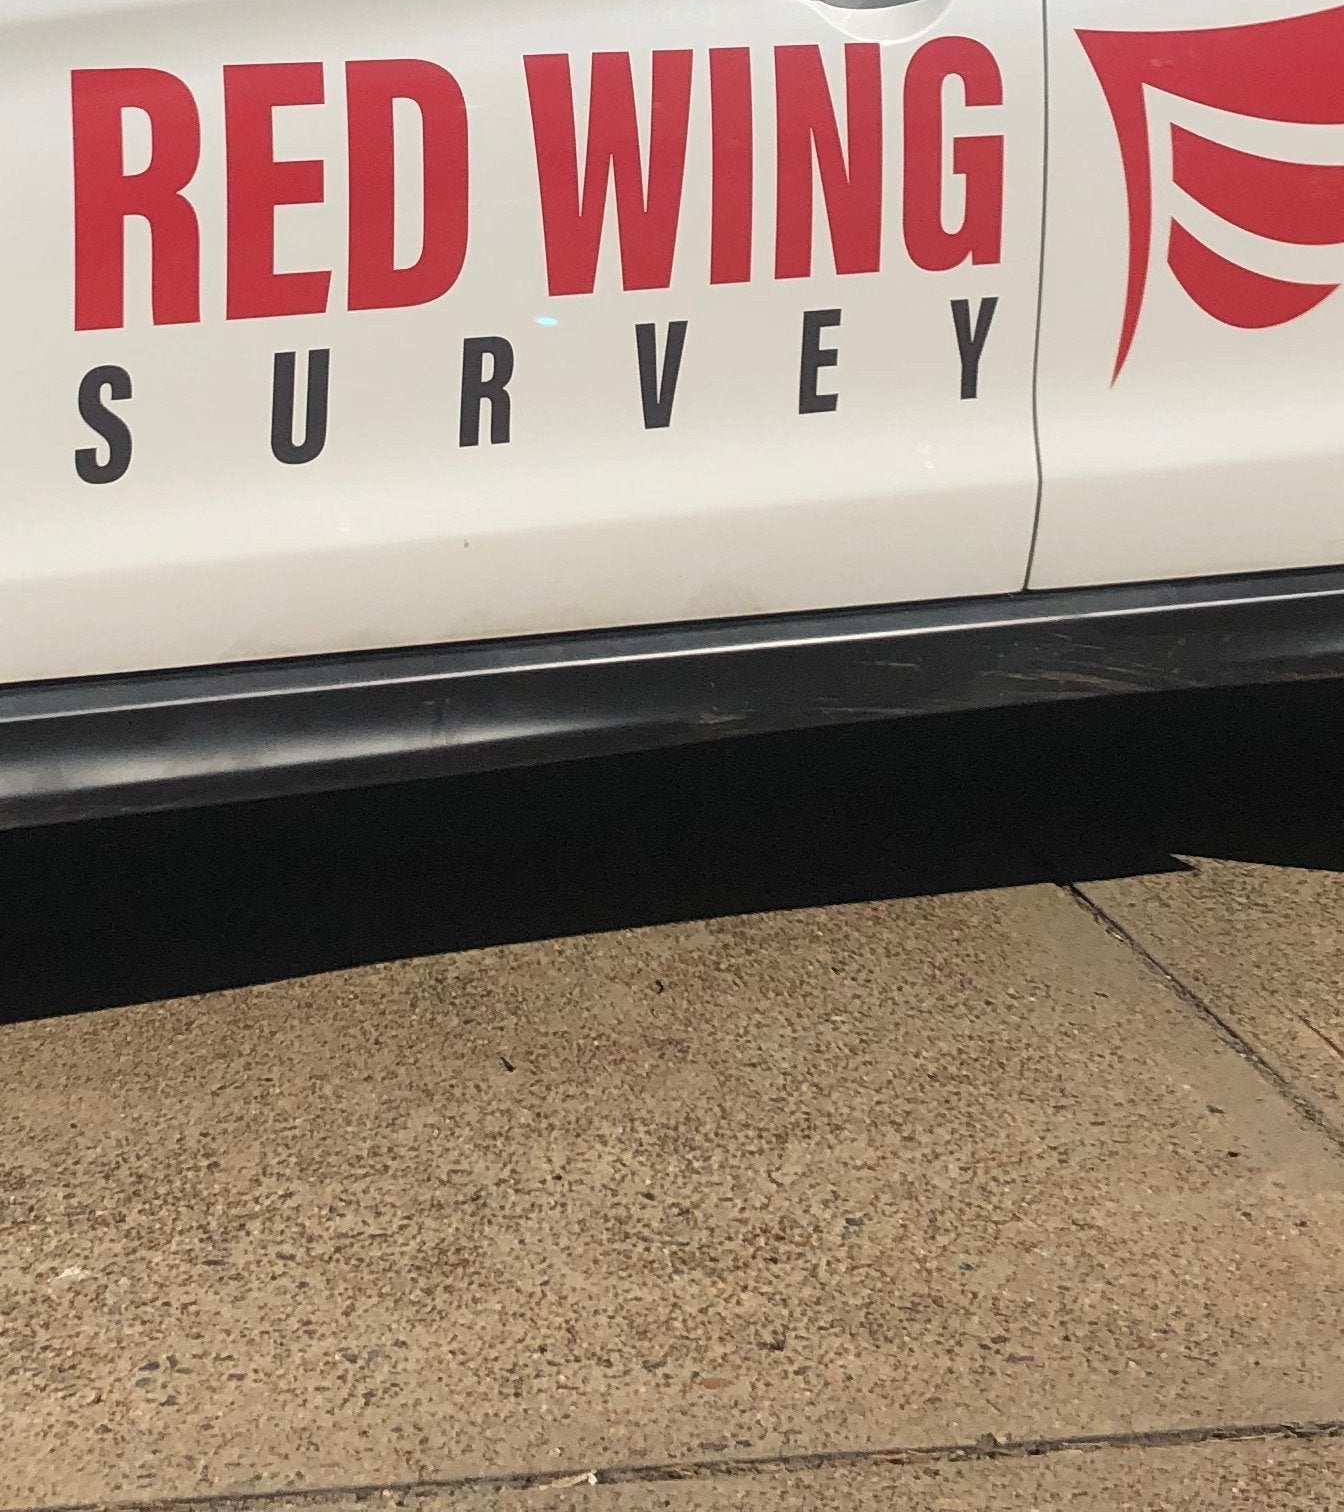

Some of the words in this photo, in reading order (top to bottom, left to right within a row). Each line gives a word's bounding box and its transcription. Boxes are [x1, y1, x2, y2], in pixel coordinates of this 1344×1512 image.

[70, 58, 469, 331] RED
[523, 35, 1004, 296] WING
[74, 295, 998, 485] SURVEY
